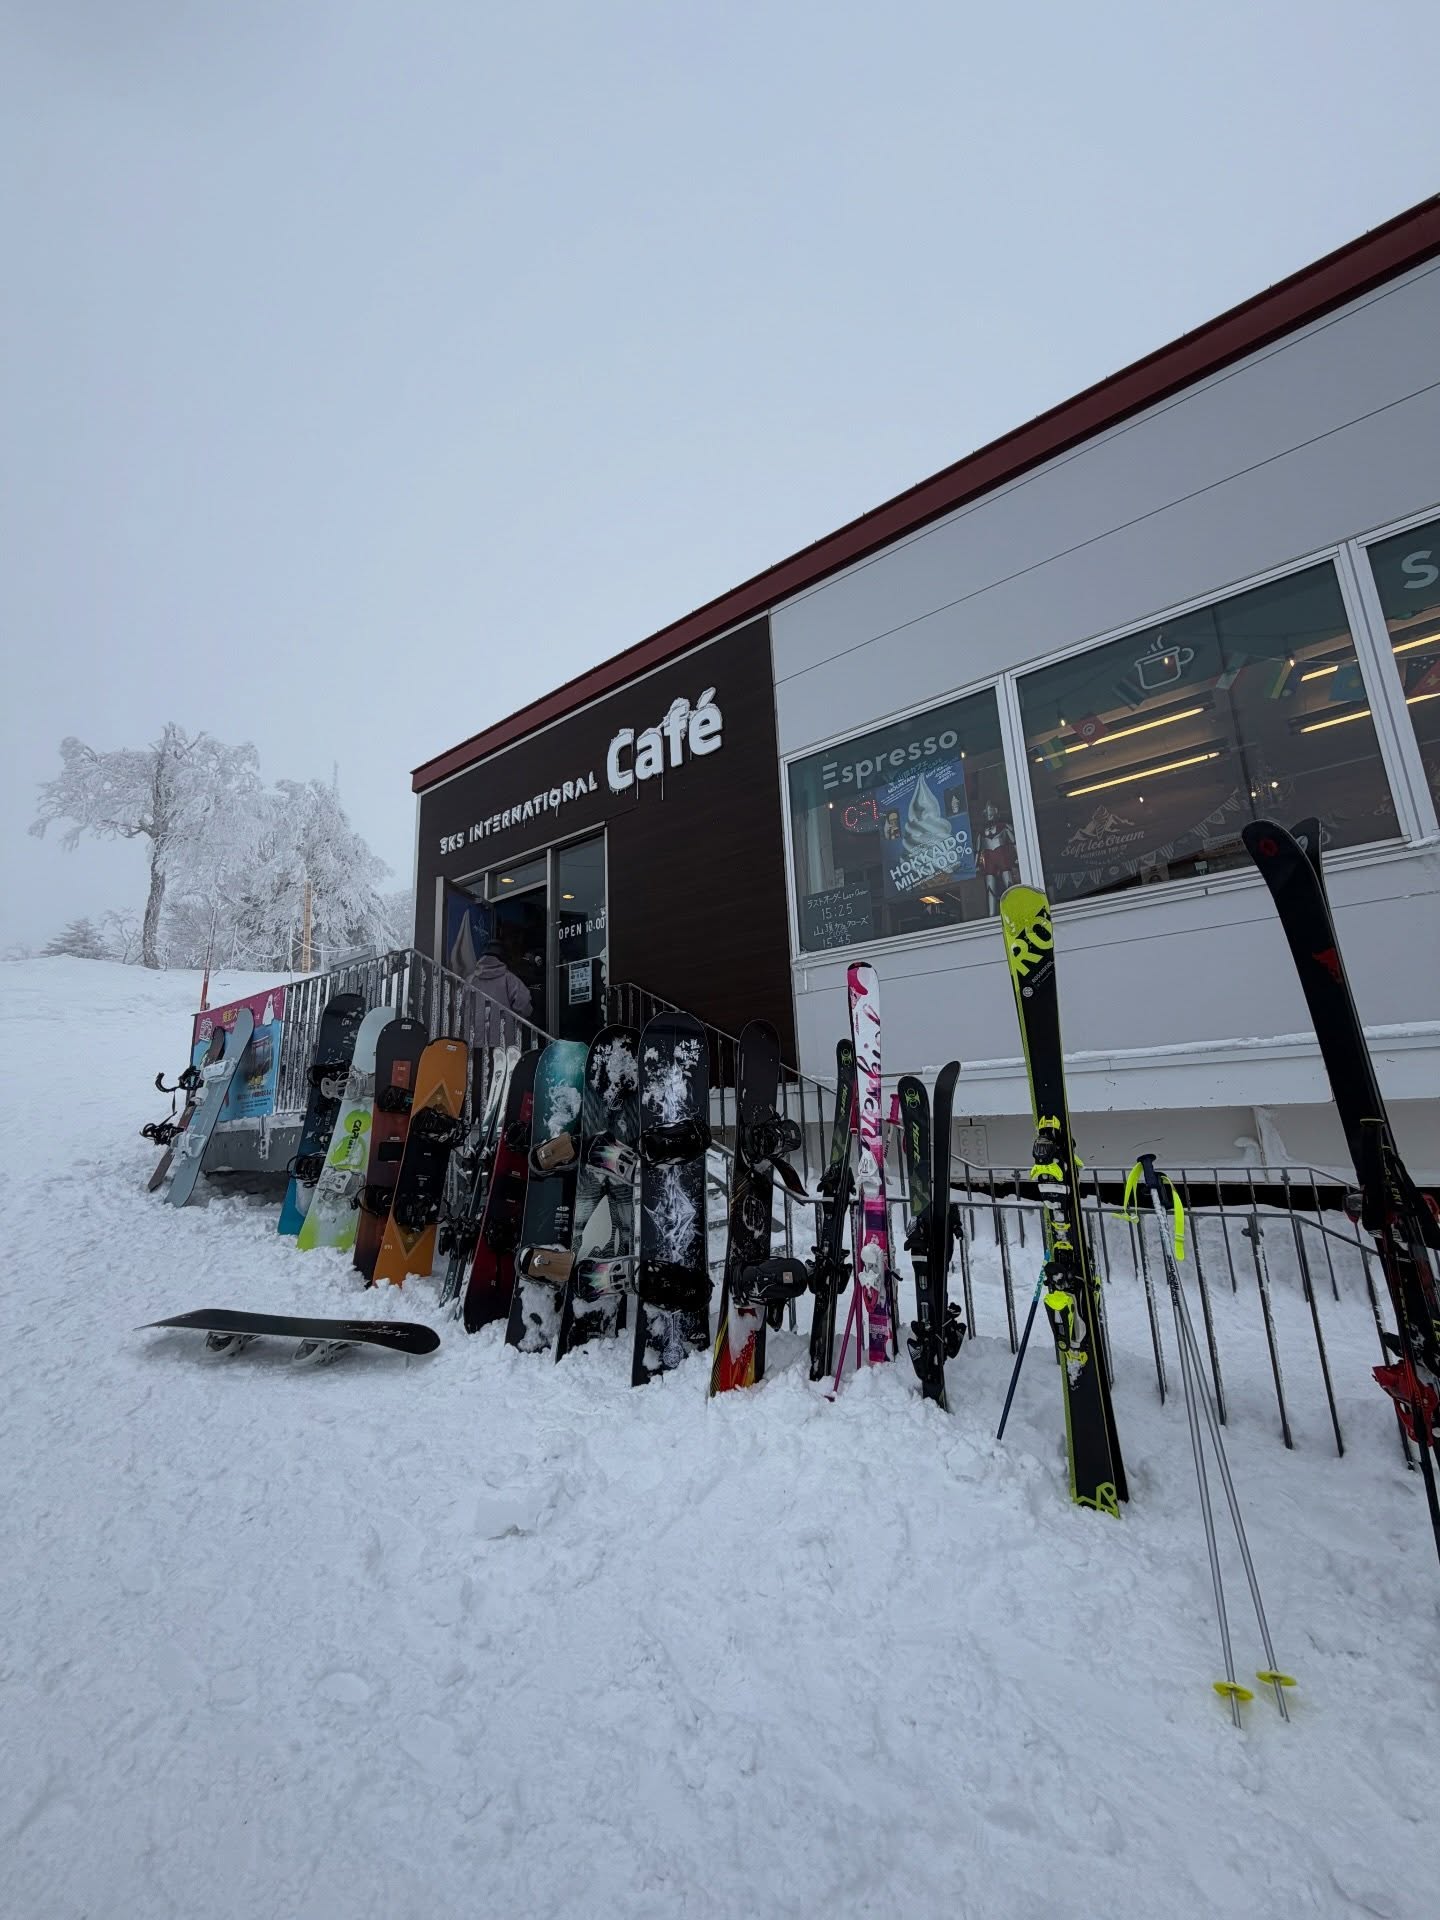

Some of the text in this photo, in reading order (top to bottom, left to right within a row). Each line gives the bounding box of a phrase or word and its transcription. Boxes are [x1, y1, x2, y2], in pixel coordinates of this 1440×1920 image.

[606, 687, 723, 793] Café
[823, 731, 958, 790] Espresso
[440, 771, 598, 855] SKS INTERNATIONAL
[890, 830, 968, 881] HOKKAIDO
[1060, 831, 1145, 858] Soft Ice Cream
[821, 902, 853, 920] 15:25
[559, 922, 582, 940] OPEN
[822, 934, 852, 949] 15:45
